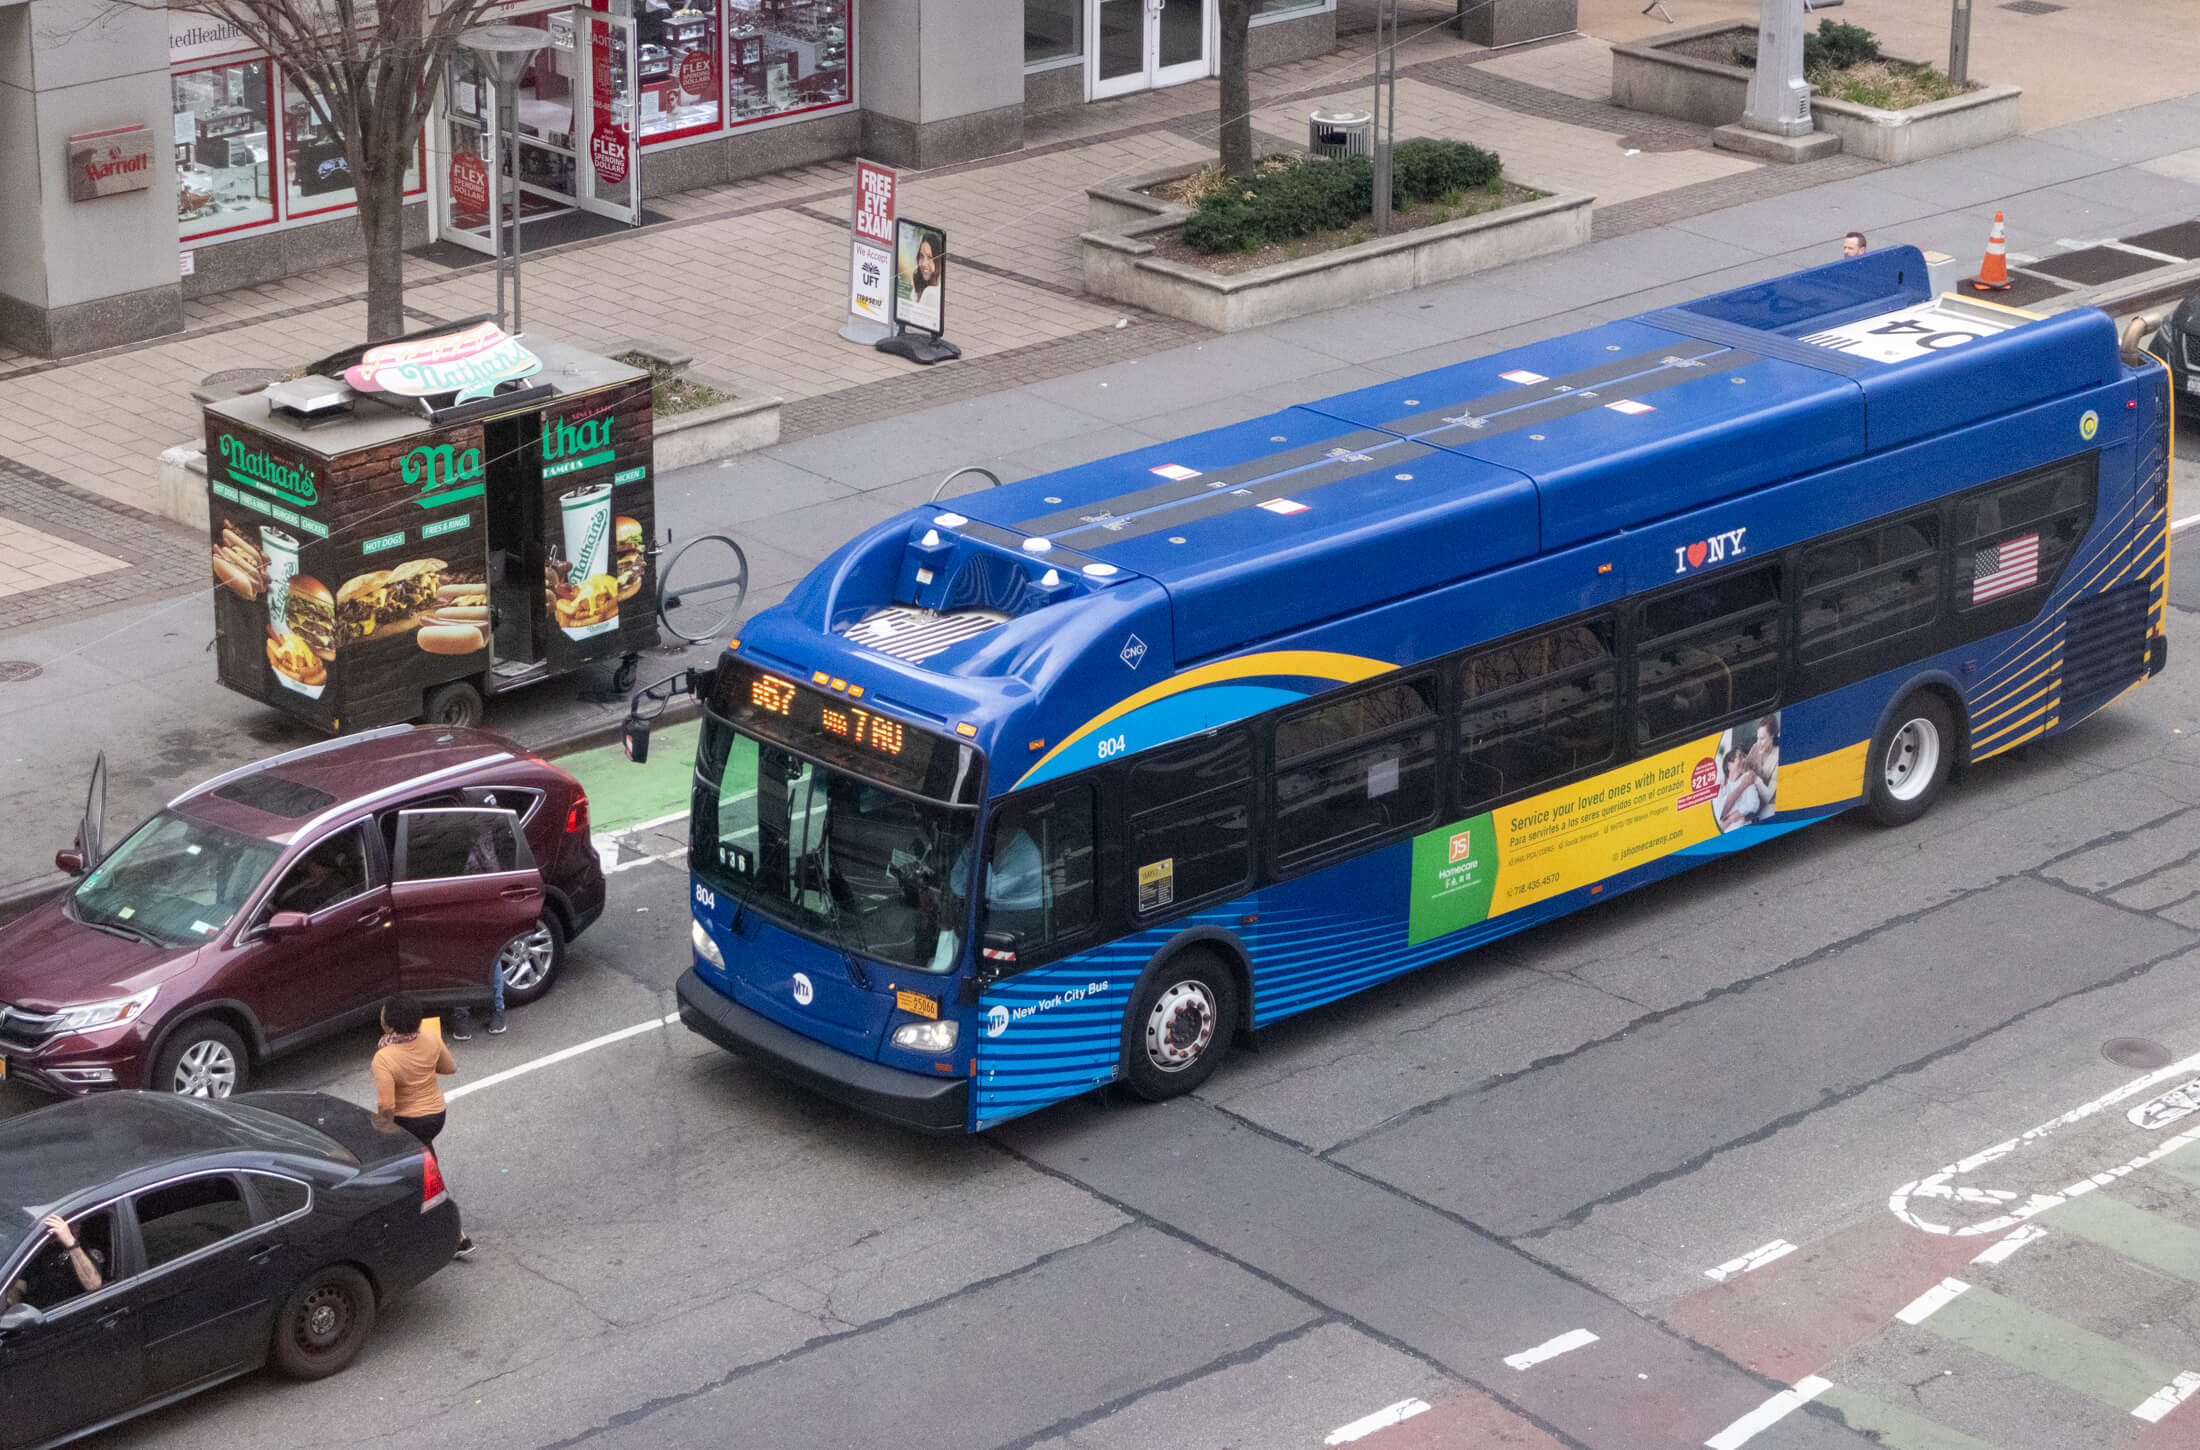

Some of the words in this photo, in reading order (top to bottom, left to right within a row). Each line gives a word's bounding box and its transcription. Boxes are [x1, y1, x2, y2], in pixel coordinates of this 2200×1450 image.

[682, 60, 710, 73] FLEX
[593, 138, 625, 160] FLEX
[594, 152, 624, 168] SPENDING
[83, 152, 148, 184] Marriott
[454, 164, 485, 186] FLEX
[594, 160, 624, 175] DOLLARS
[454, 185, 485, 202] DOLLARS
[861, 168, 892, 199] FREE
[864, 190, 889, 218] EYE
[857, 209, 892, 241] EXAM
[856, 243, 866, 257] We
[867, 248, 888, 265] Accept
[862, 273, 879, 289] UFT
[400, 342, 530, 391] Nathan's
[219, 433, 316, 498] Nathan's
[400, 443, 484, 492] Na
[302, 518, 328, 536] CHICKEN
[425, 524, 441, 536] FRIES
[366, 539, 380, 551] HOT
[382, 535, 402, 547] DOGS
[1675, 546, 1687, 574] I
[1124, 644, 1144, 659] CNG
[851, 707, 870, 742] 7
[1098, 734, 1126, 759] 804
[1510, 809, 1550, 833] Service
[1552, 802, 1575, 822] your
[1578, 788, 1605, 811] loved
[1608, 782, 1632, 800] ones
[1635, 771, 1655, 790] with
[1658, 760, 1684, 782] heart
[1510, 834, 1526, 848] Para
[1528, 823, 1560, 841] servirles
[1561, 821, 1566, 831] a
[1568, 816, 1579, 828] los
[1580, 810, 1600, 824] seres
[1602, 797, 1632, 818] queridos
[1633, 793, 1646, 805] con
[1648, 788, 1655, 800] el
[1452, 838, 1467, 860] JS
[1620, 829, 1684, 861] jshomecareny.com
[1438, 859, 1479, 880] Homecare
[696, 884, 715, 910] 804
[793, 979, 809, 999] MTA
[1012, 1005, 1036, 1020] New
[1038, 995, 1062, 1012] York
[1064, 988, 1085, 1003] City
[1088, 980, 1108, 995] Bus
